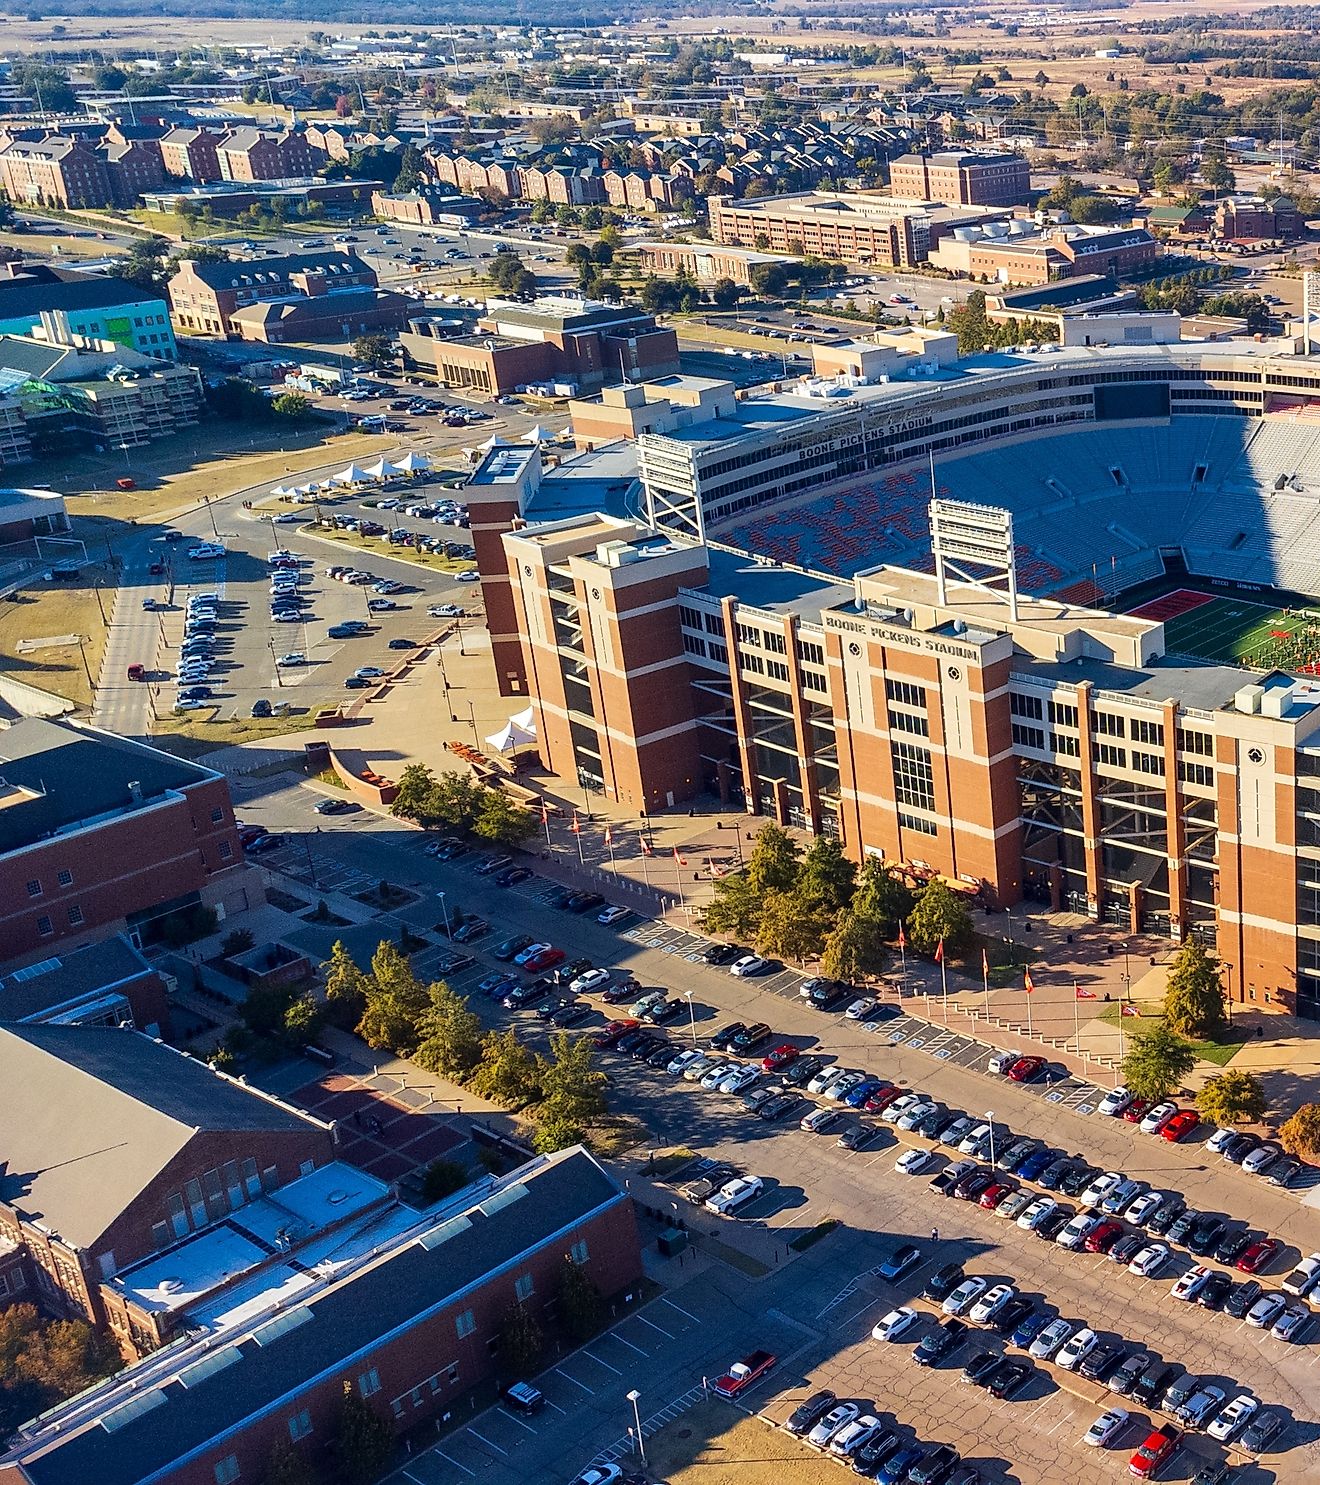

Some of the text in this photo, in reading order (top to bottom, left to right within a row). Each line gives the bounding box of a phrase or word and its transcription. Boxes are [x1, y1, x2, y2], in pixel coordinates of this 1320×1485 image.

[799, 416, 933, 460] BOONE PICKENS STADIUM
[826, 616, 979, 664] BOONE PICKENS STADIUM
